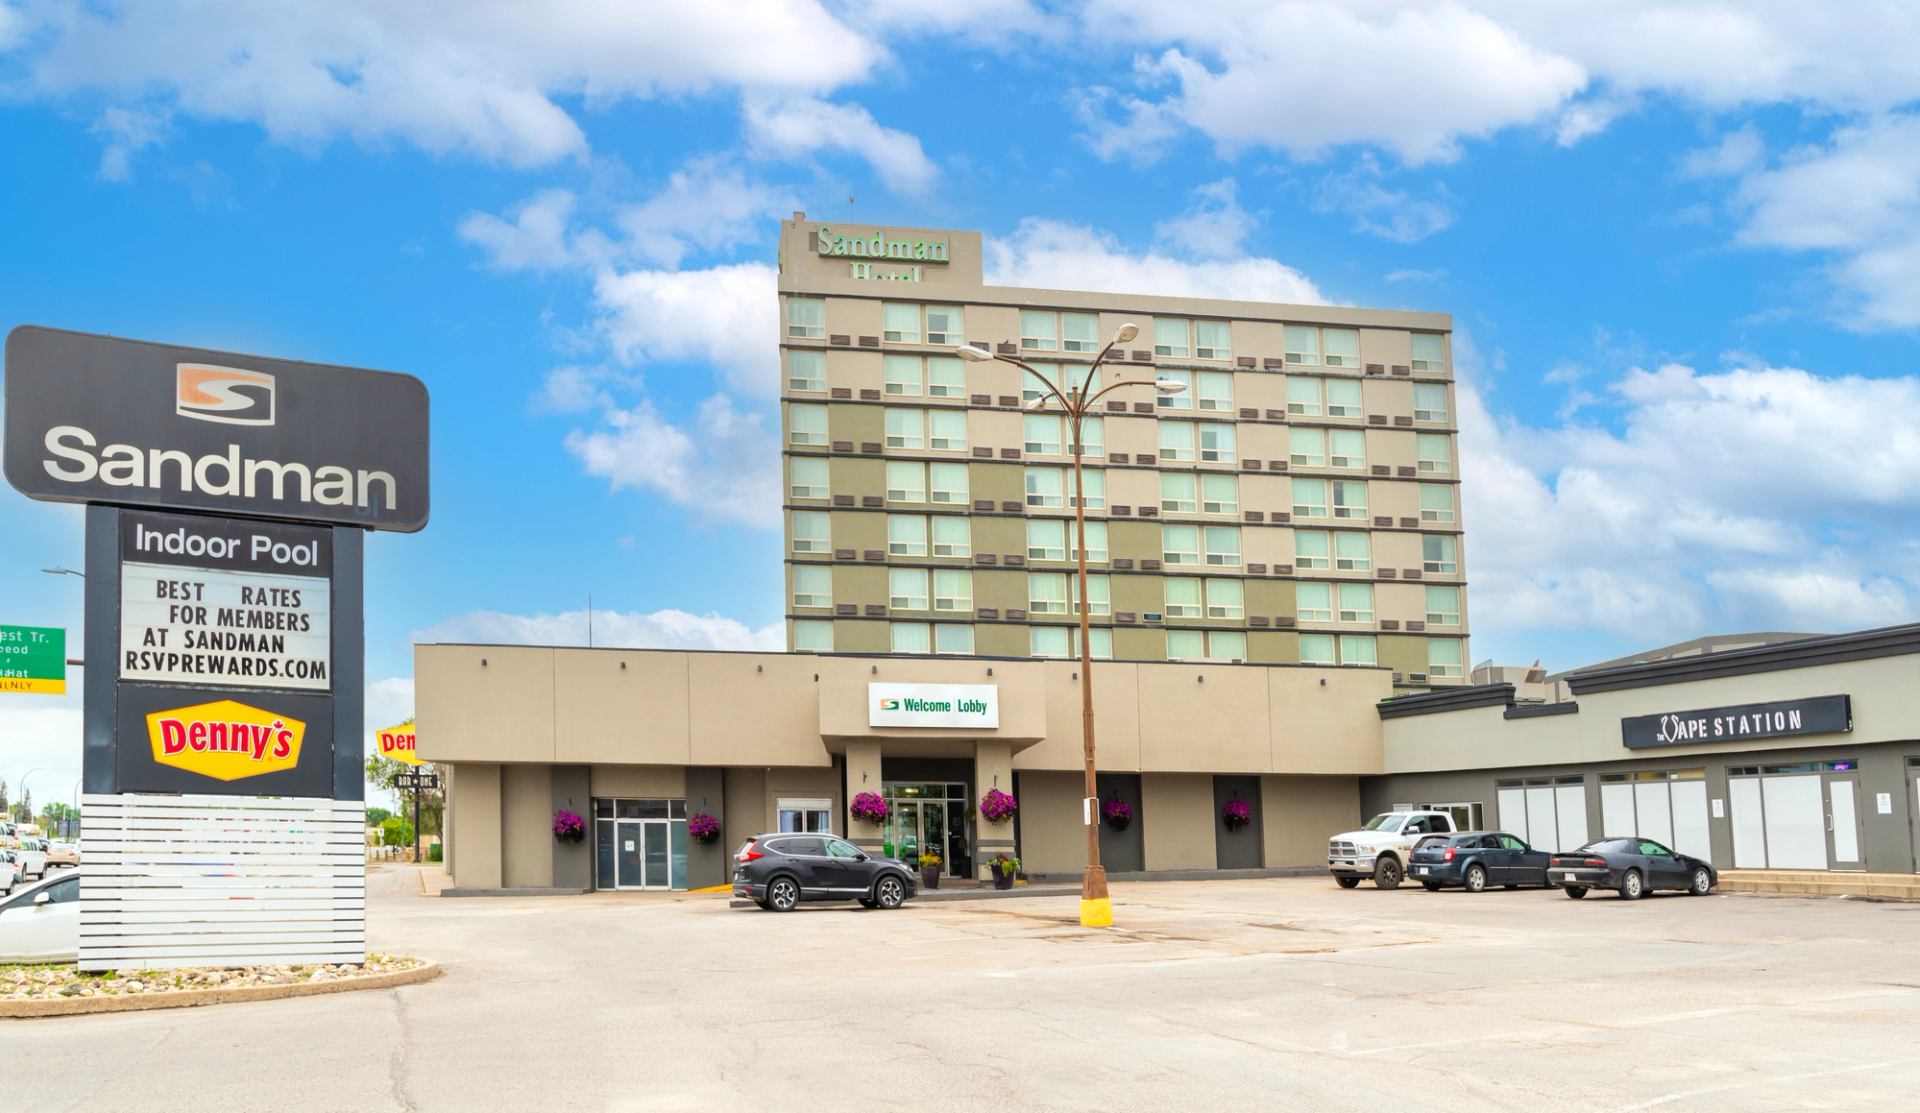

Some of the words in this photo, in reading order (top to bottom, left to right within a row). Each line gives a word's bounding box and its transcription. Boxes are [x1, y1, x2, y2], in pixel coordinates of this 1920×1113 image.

[816, 225, 950, 261] Sandman
[42, 425, 397, 510] Sandman
[136, 523, 241, 559] Indoor
[251, 534, 318, 567] Pool
[156, 579, 205, 602] BEST
[241, 586, 302, 609] RATES
[169, 604, 207, 626] FOR
[217, 607, 310, 633] MEMBERS
[0, 630, 22, 642] est
[30, 631, 49, 643] Tr.
[143, 627, 169, 648] AT
[184, 629, 285, 654] SANDMAN
[126, 650, 327, 680] RSVPREWARDS.COM
[903, 698, 951, 713] Welcome
[957, 698, 987, 716] Lobby
[1713, 709, 1802, 737] STATION
[158, 718, 293, 761] Denny's
[381, 732, 416, 753] Den
